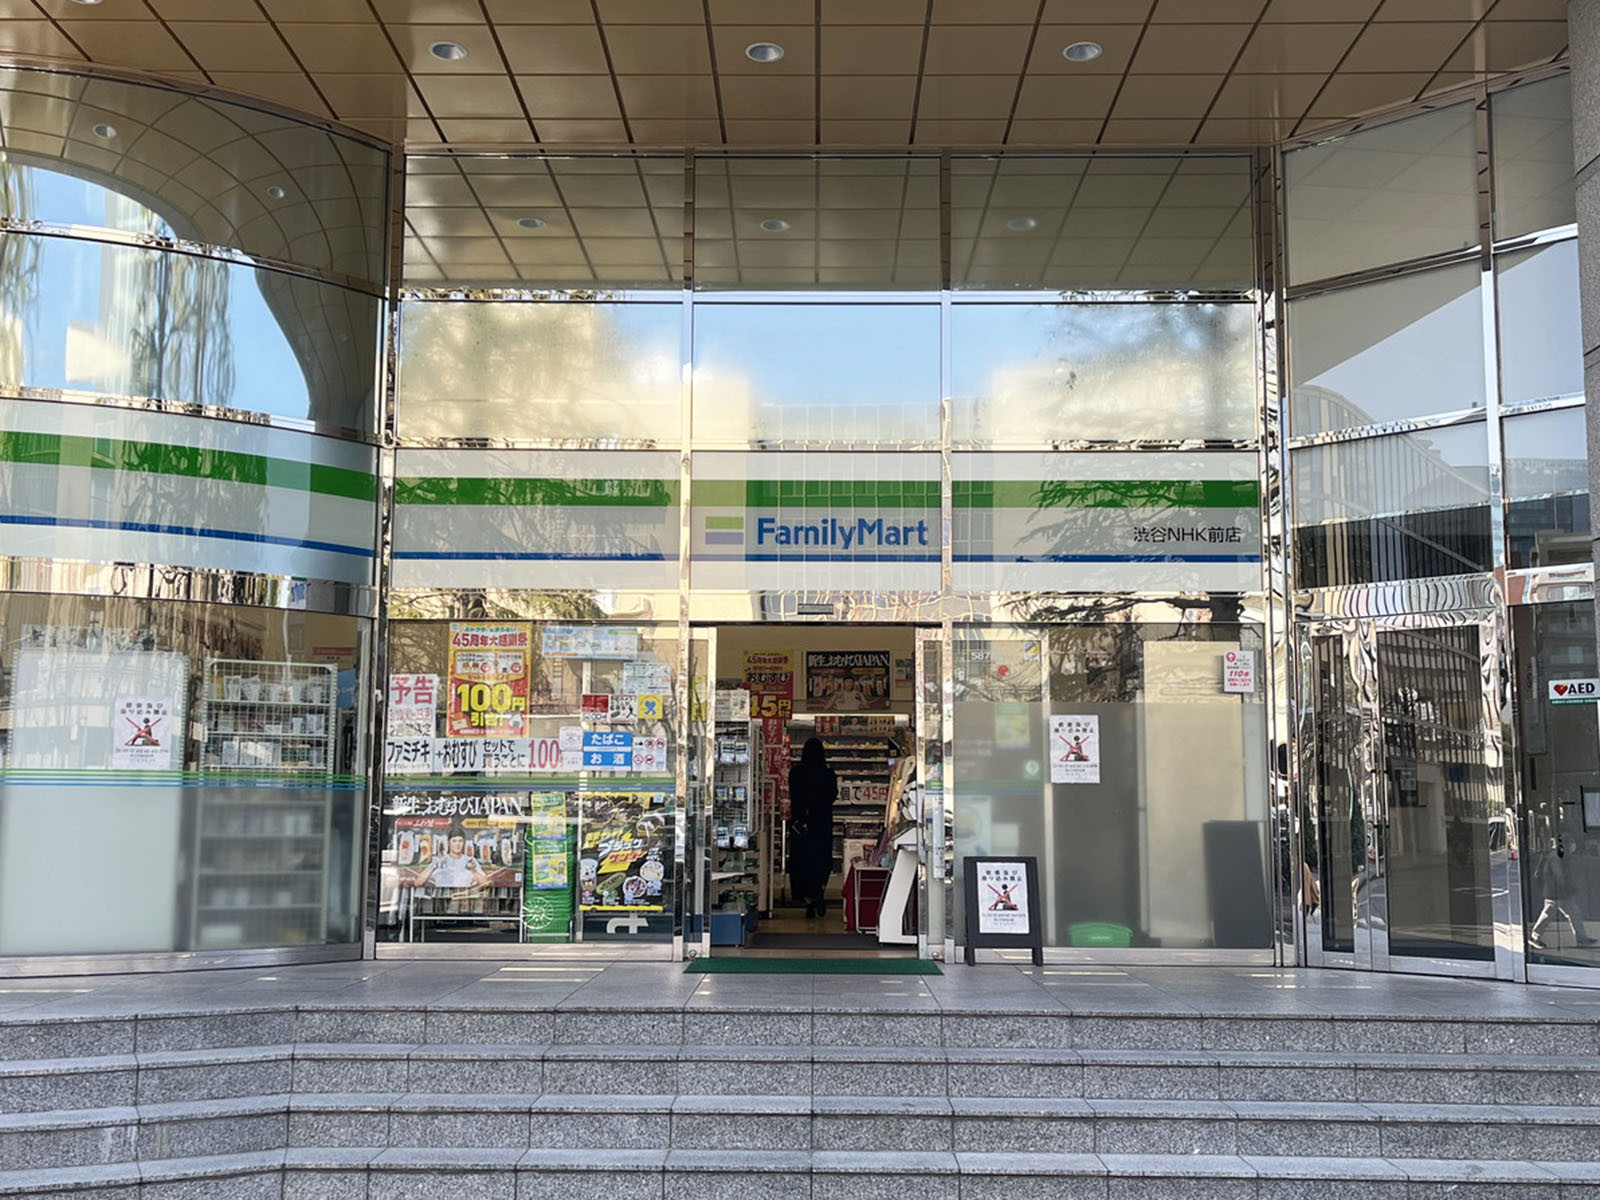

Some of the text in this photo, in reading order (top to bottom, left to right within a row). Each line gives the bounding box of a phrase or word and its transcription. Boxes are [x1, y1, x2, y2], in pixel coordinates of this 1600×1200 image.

[757, 517, 929, 550] FamilyMart
[1133, 526, 1241, 543] 渋谷NHK前店
[391, 676, 434, 705] 予告
[457, 683, 526, 712] 100円
[1568, 683, 1595, 695] AED
[482, 740, 516, 753] セットで
[591, 733, 624, 745] たばこ
[387, 740, 430, 763] ファミチキ
[590, 753, 625, 765] お酒
